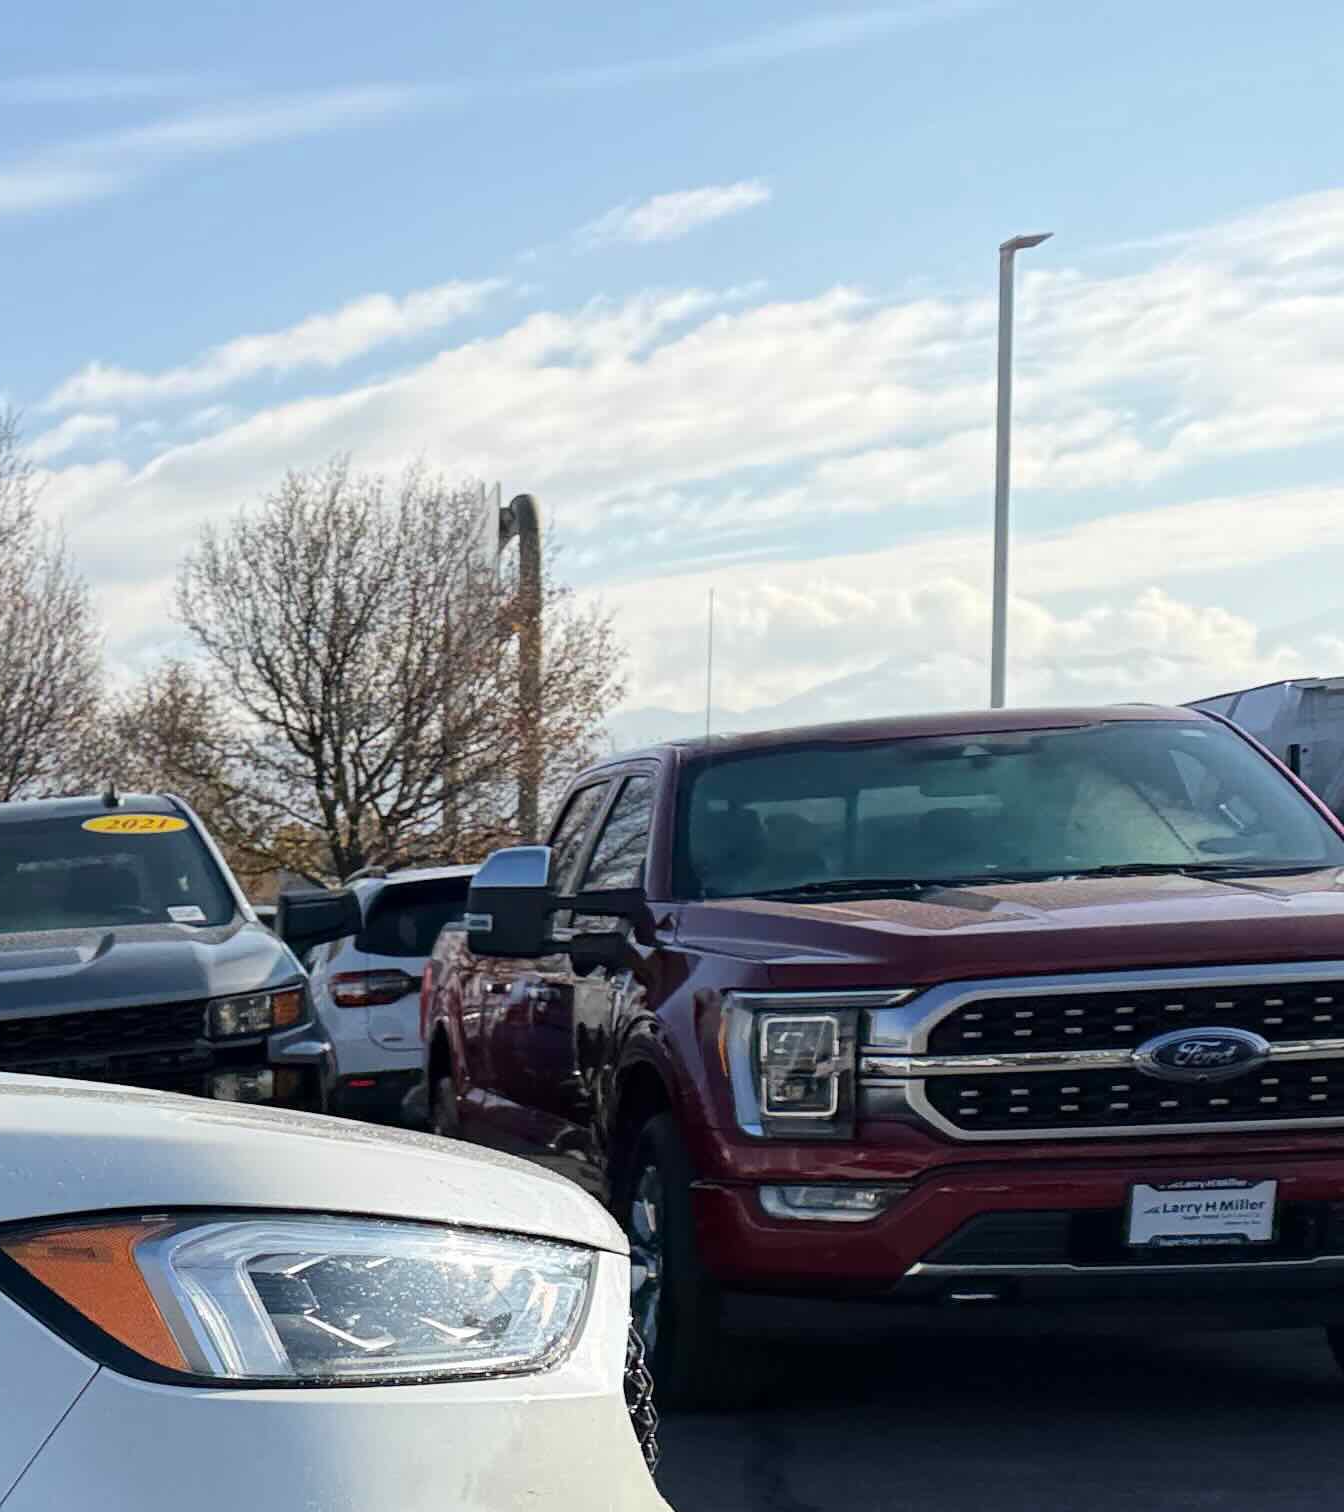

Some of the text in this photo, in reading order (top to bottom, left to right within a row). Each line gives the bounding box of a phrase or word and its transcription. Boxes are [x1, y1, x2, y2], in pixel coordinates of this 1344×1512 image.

[104, 818, 169, 830] 2021
[1174, 1040, 1238, 1065] Ford
[1162, 1199, 1265, 1214] Larry H Miller
